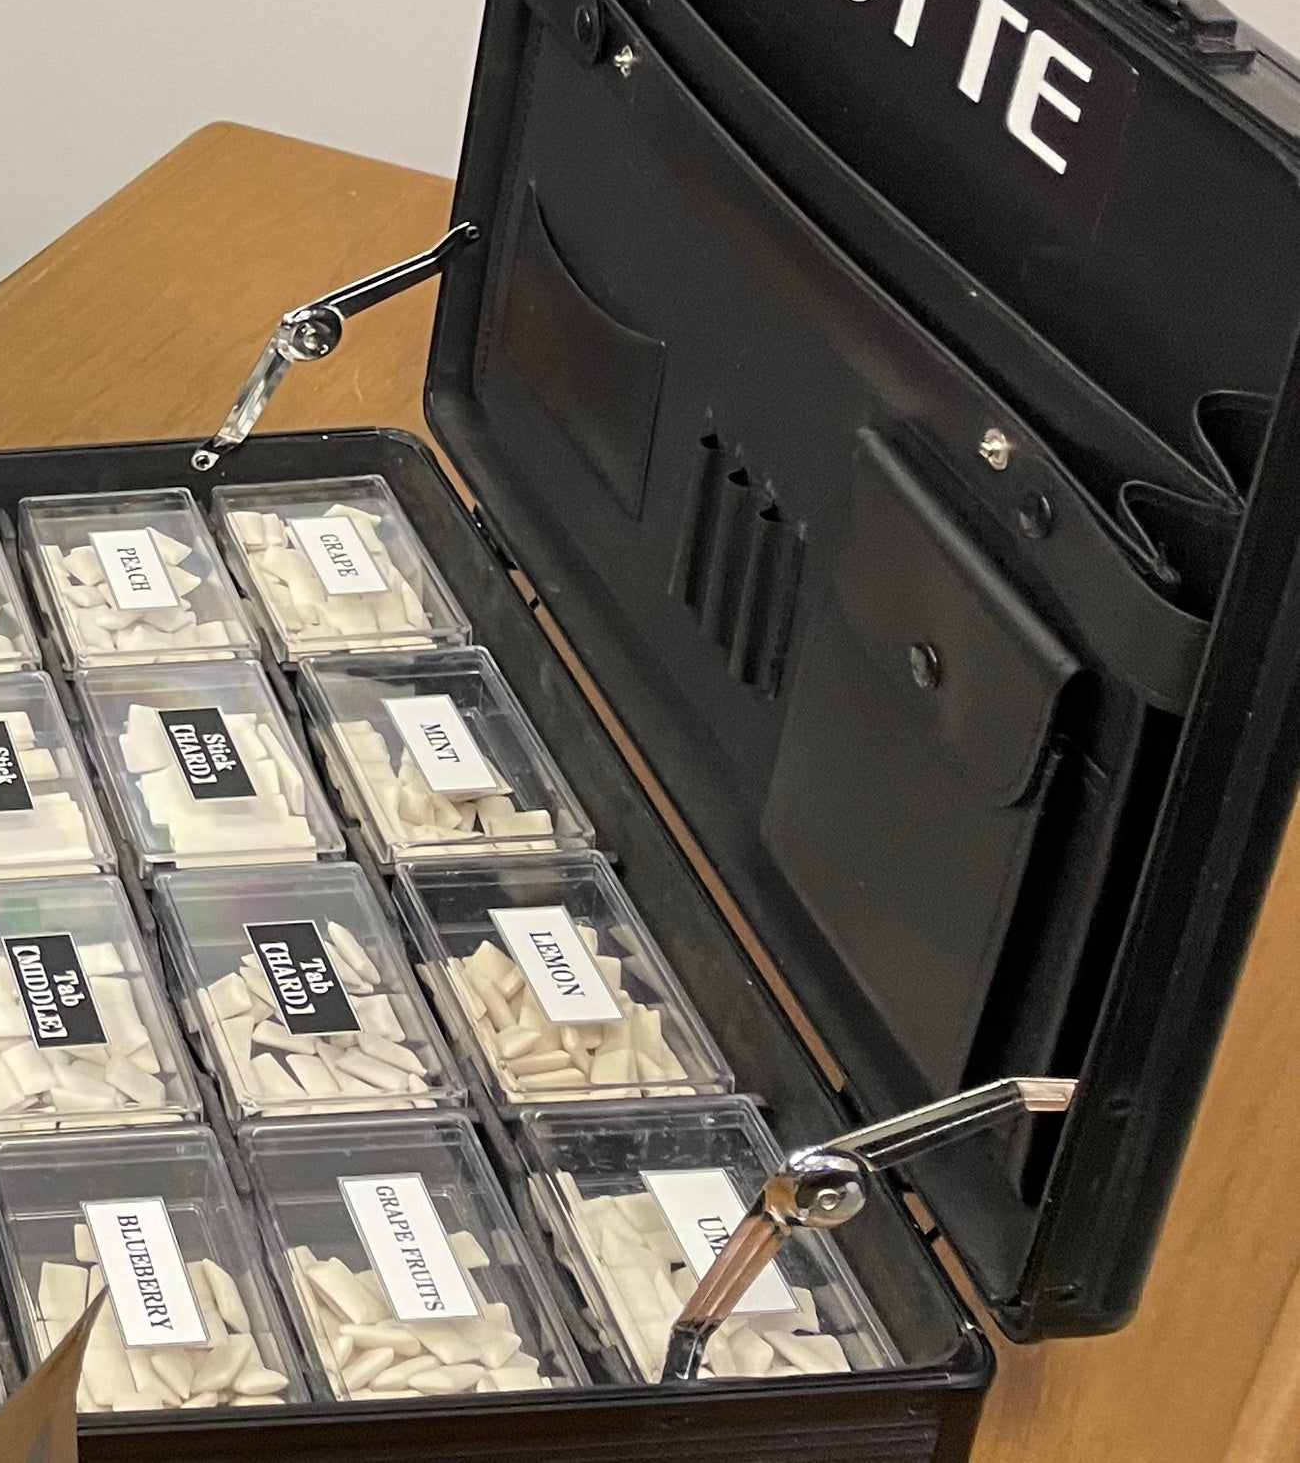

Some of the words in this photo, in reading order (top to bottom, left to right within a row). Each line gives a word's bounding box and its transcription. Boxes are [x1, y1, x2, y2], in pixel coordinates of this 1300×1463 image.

[116, 546, 152, 593] PEACH
[319, 532, 359, 578] GRAPE
[202, 733, 237, 772] Stick
[419, 722, 460, 764] MINT
[299, 957, 335, 994] Tab
[528, 930, 587, 998] LEMON
[53, 969, 85, 1007] Tab
[375, 1185, 415, 1242] GRAPE
[401, 1247, 446, 1312] FRUITS
[116, 1214, 174, 1331] BLUEBERRY
